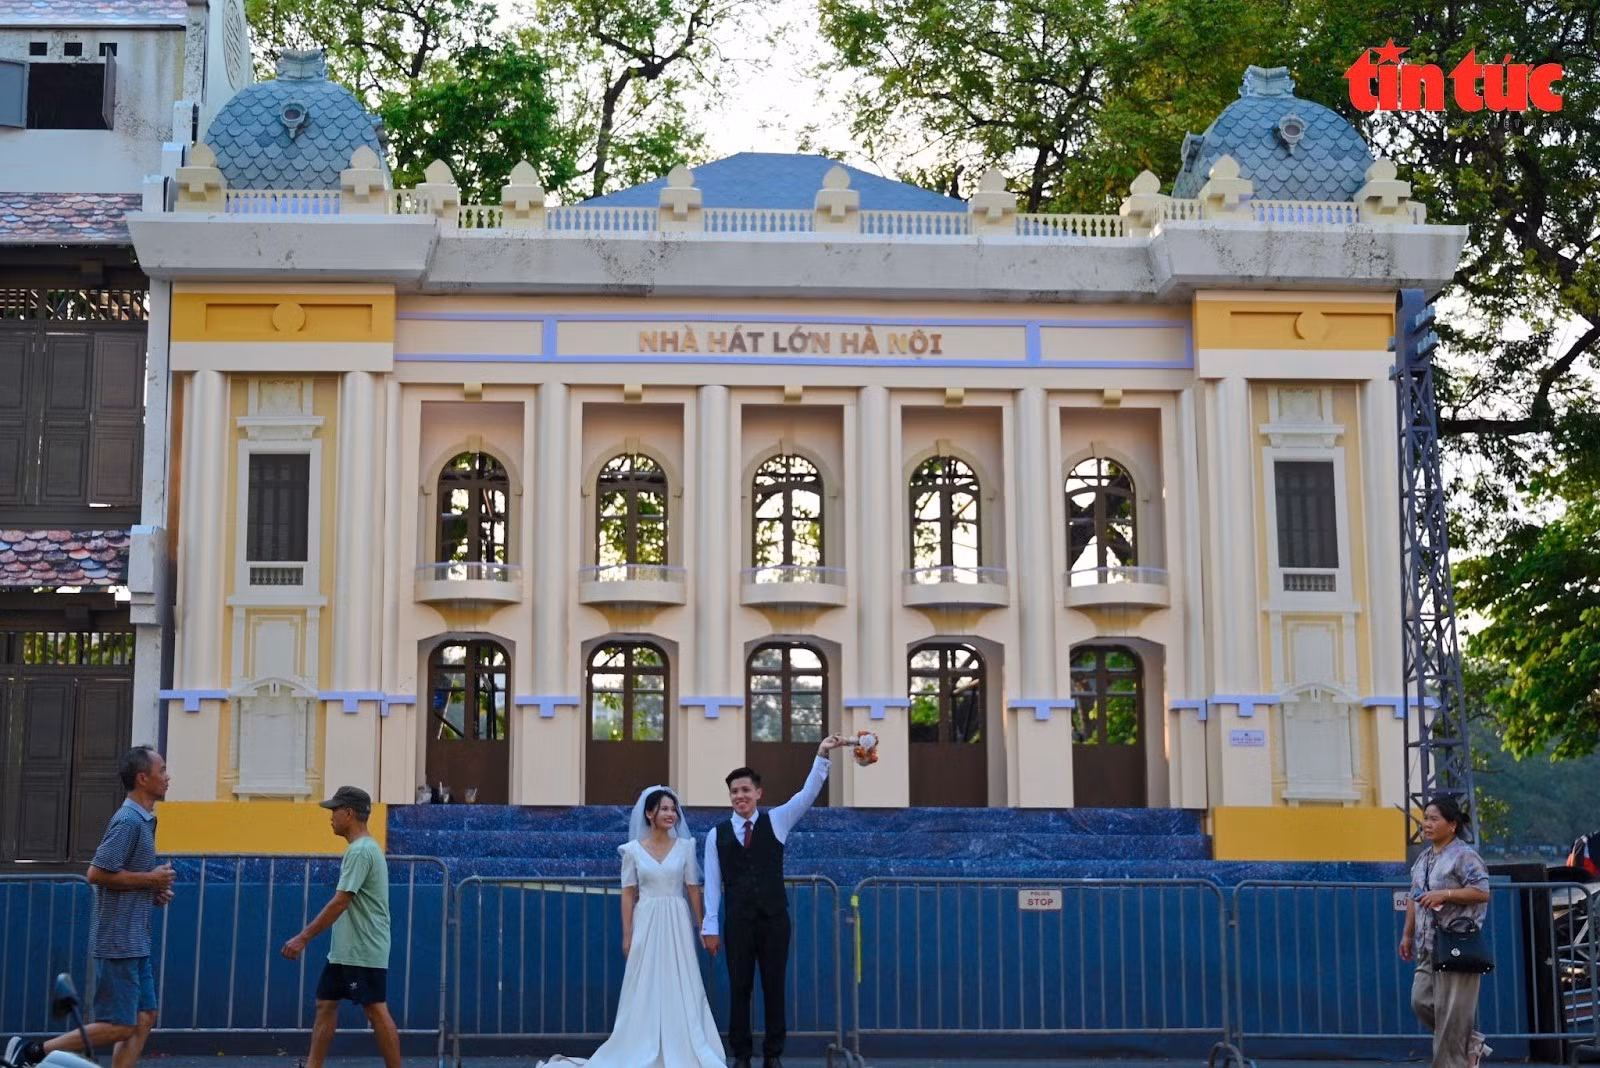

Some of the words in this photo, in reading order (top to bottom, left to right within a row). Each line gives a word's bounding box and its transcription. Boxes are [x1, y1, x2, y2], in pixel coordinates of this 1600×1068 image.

[640, 324, 699, 352] NHÀ
[708, 324, 764, 352] HÁT
[773, 325, 830, 353] LỚN
[841, 325, 880, 354] HÀ
[888, 329, 942, 359] NỘI
[1027, 898, 1053, 906] STOP
